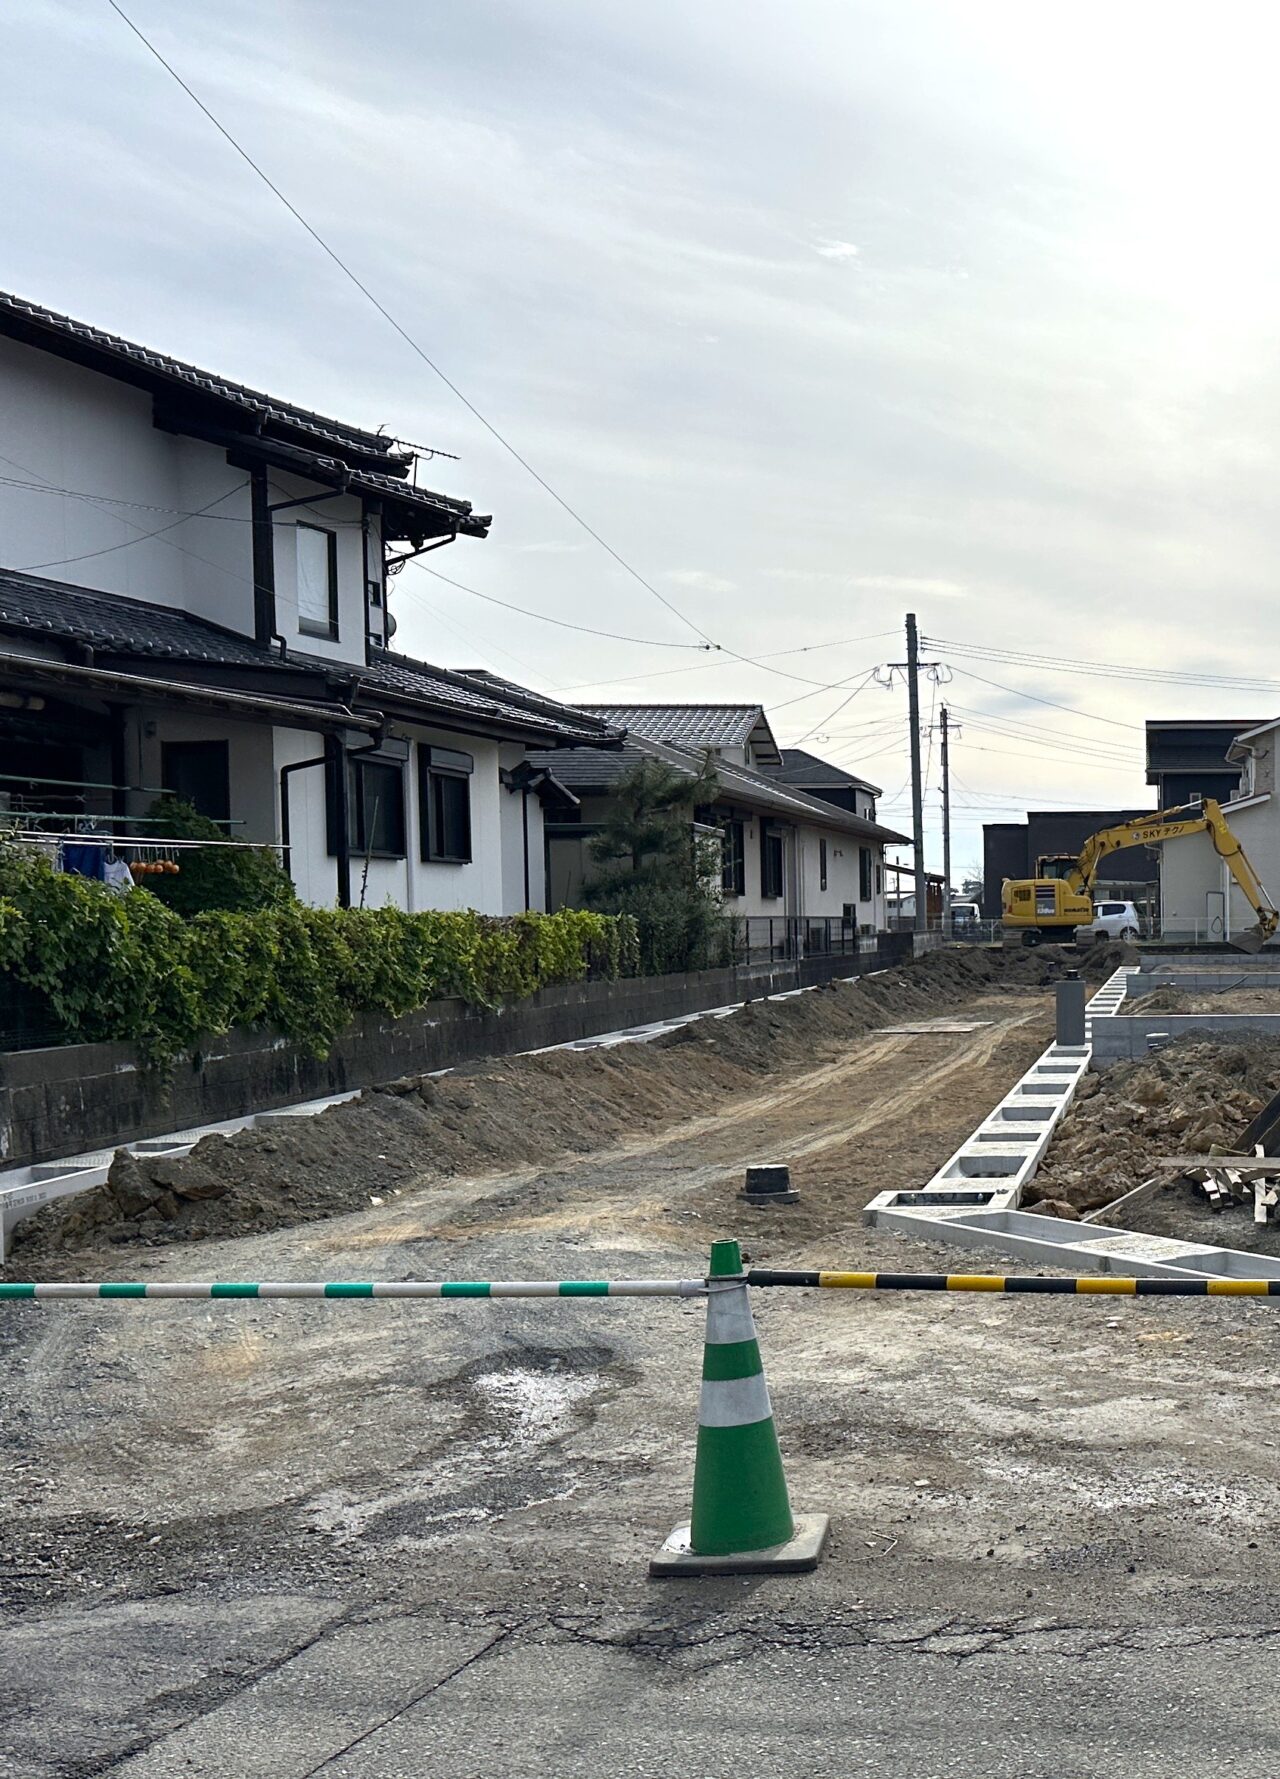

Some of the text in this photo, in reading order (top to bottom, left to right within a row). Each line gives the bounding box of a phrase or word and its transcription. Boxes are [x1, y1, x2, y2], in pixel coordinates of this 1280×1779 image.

[1143, 825, 1184, 839] SKY テクノ
